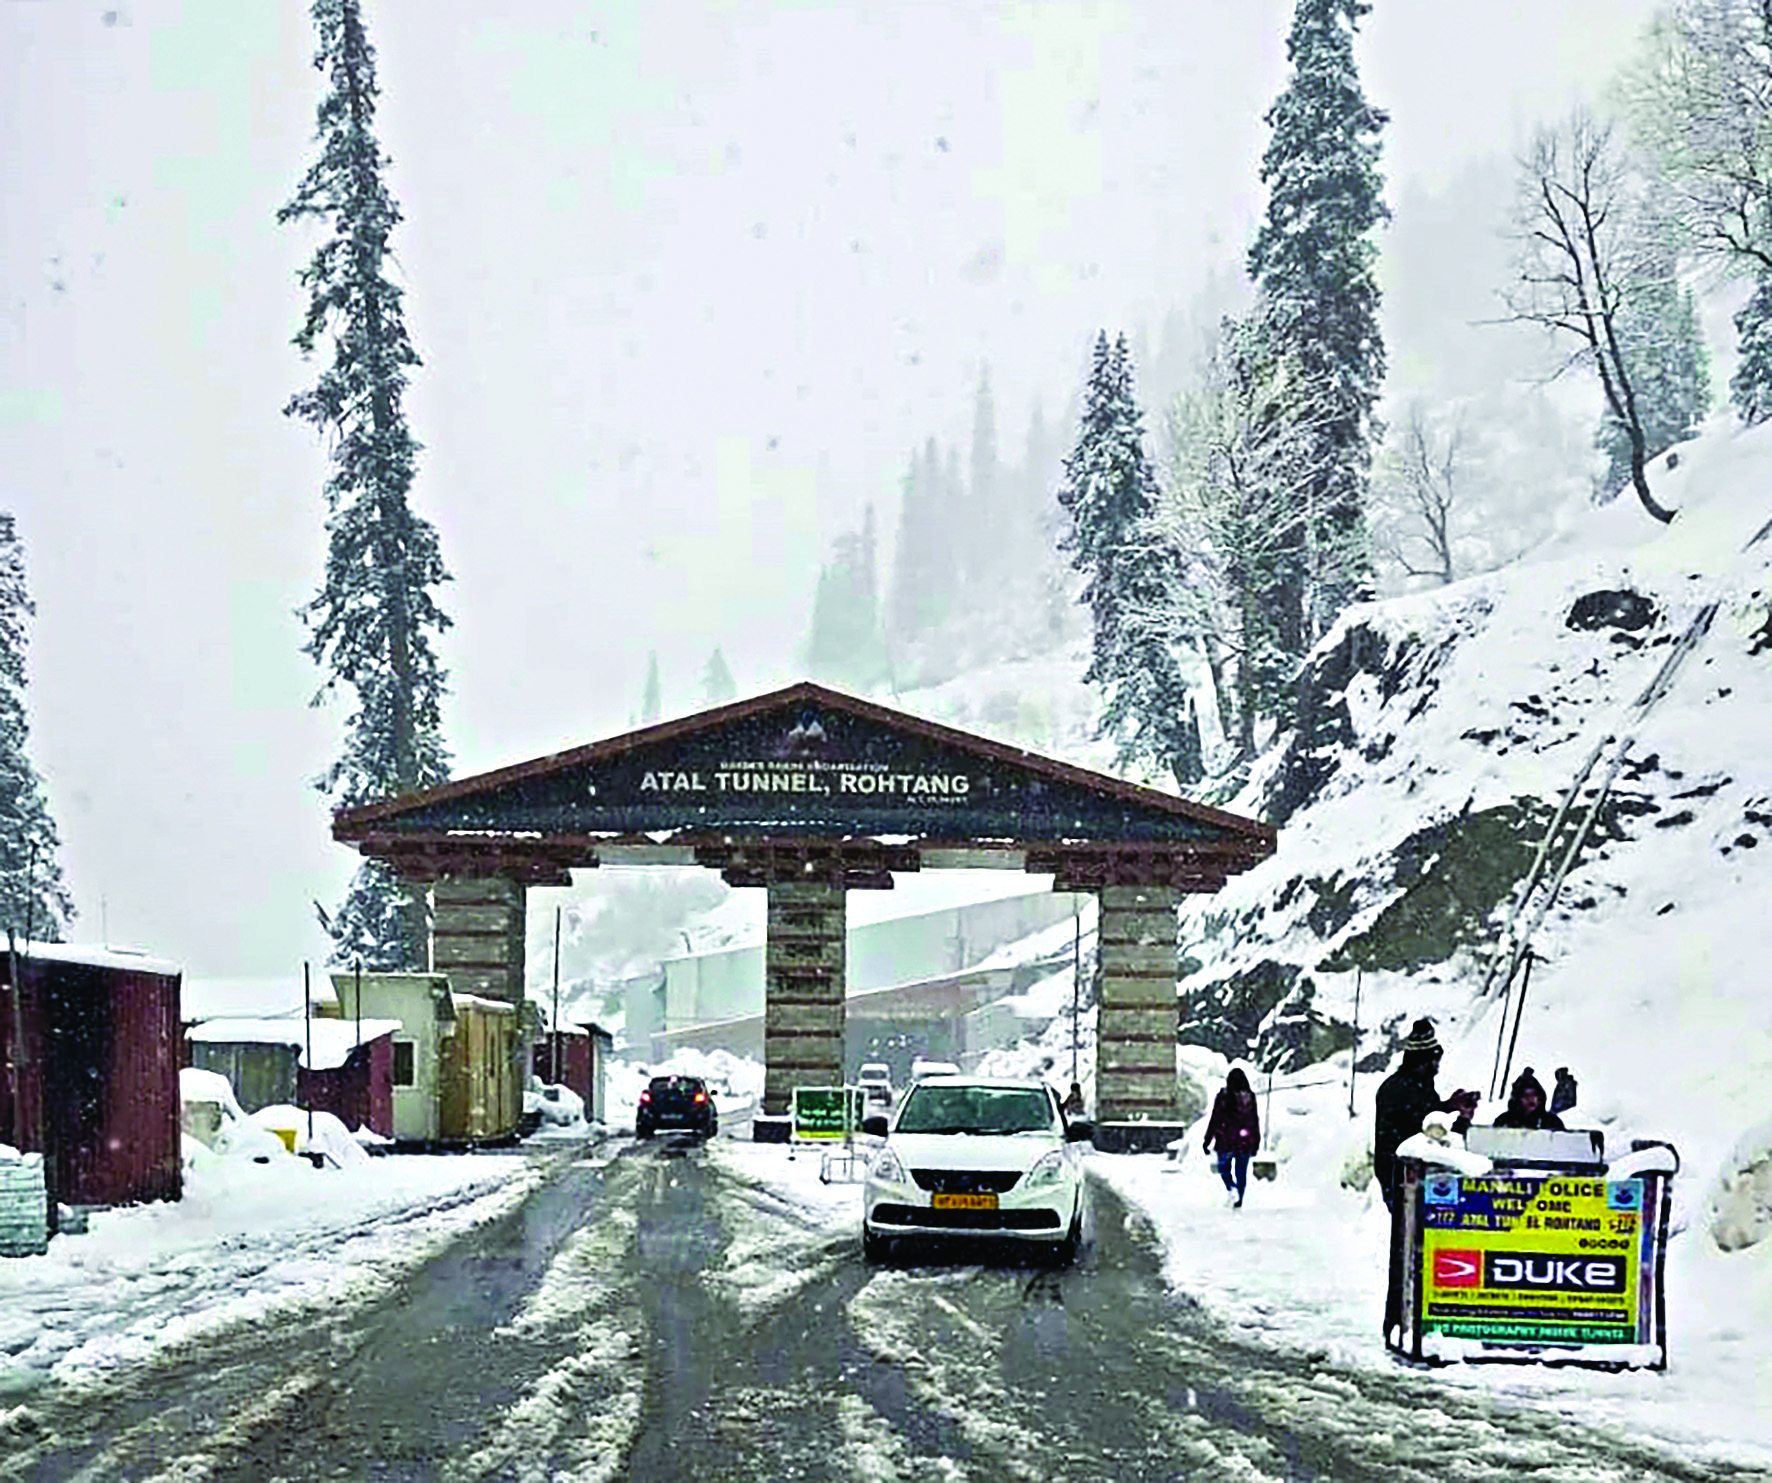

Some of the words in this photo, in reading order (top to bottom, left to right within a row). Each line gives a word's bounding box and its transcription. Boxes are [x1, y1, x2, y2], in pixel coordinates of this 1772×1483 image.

[640, 772, 706, 790] ATAL
[714, 772, 830, 795] TUNNEL,
[840, 774, 970, 793] ROHTANG
[1462, 1179, 1532, 1195] MANALI
[1541, 1182, 1604, 1198] OLICE
